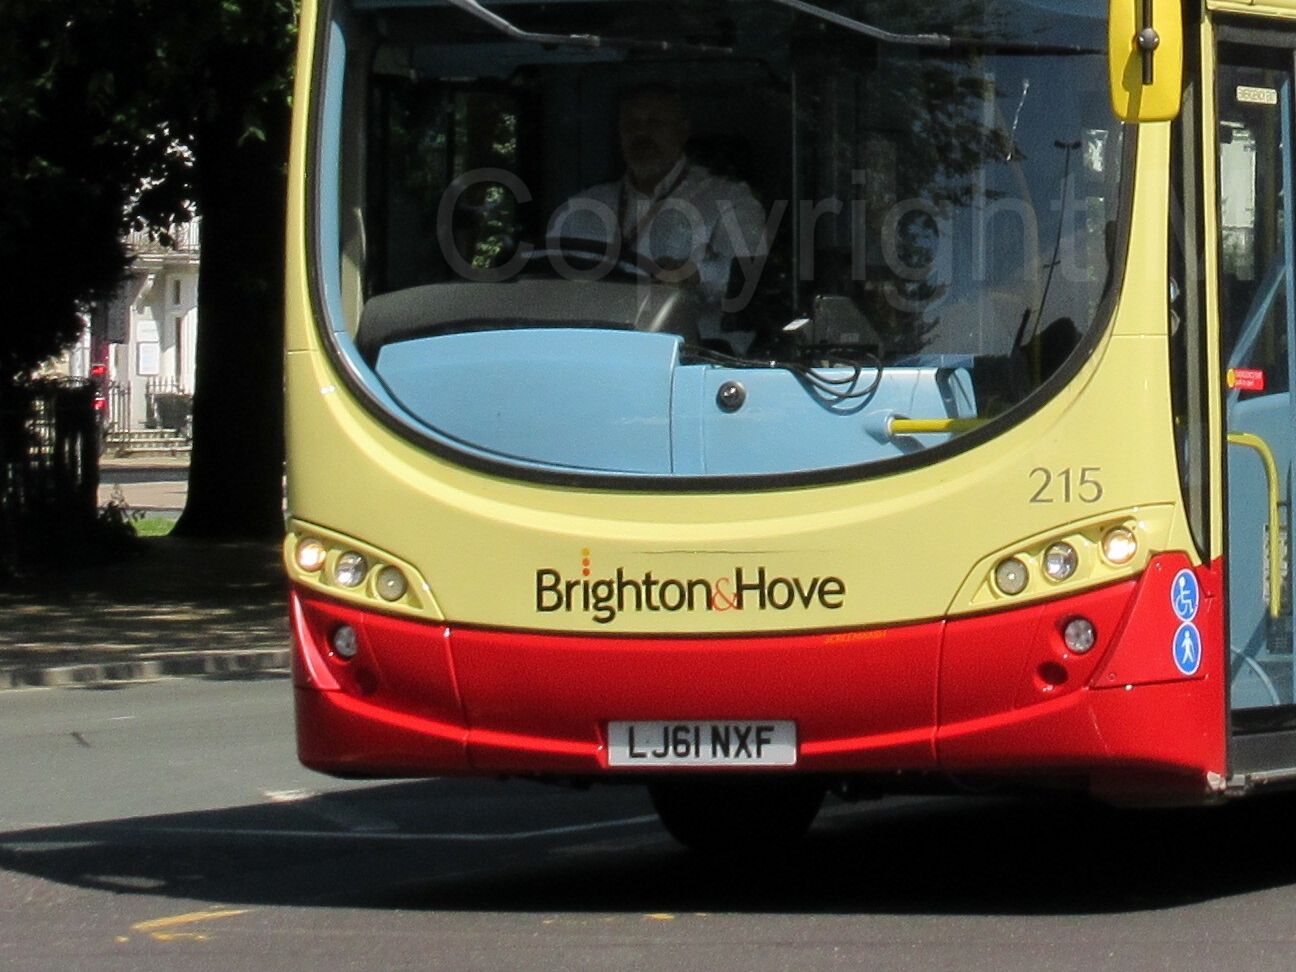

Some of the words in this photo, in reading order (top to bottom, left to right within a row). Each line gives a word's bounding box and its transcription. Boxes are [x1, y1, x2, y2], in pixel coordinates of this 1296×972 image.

[1028, 466, 1104, 505] 215
[536, 554, 846, 623] Brighton&Hove
[628, 726, 700, 758] LJ61
[711, 726, 775, 758] NXF
